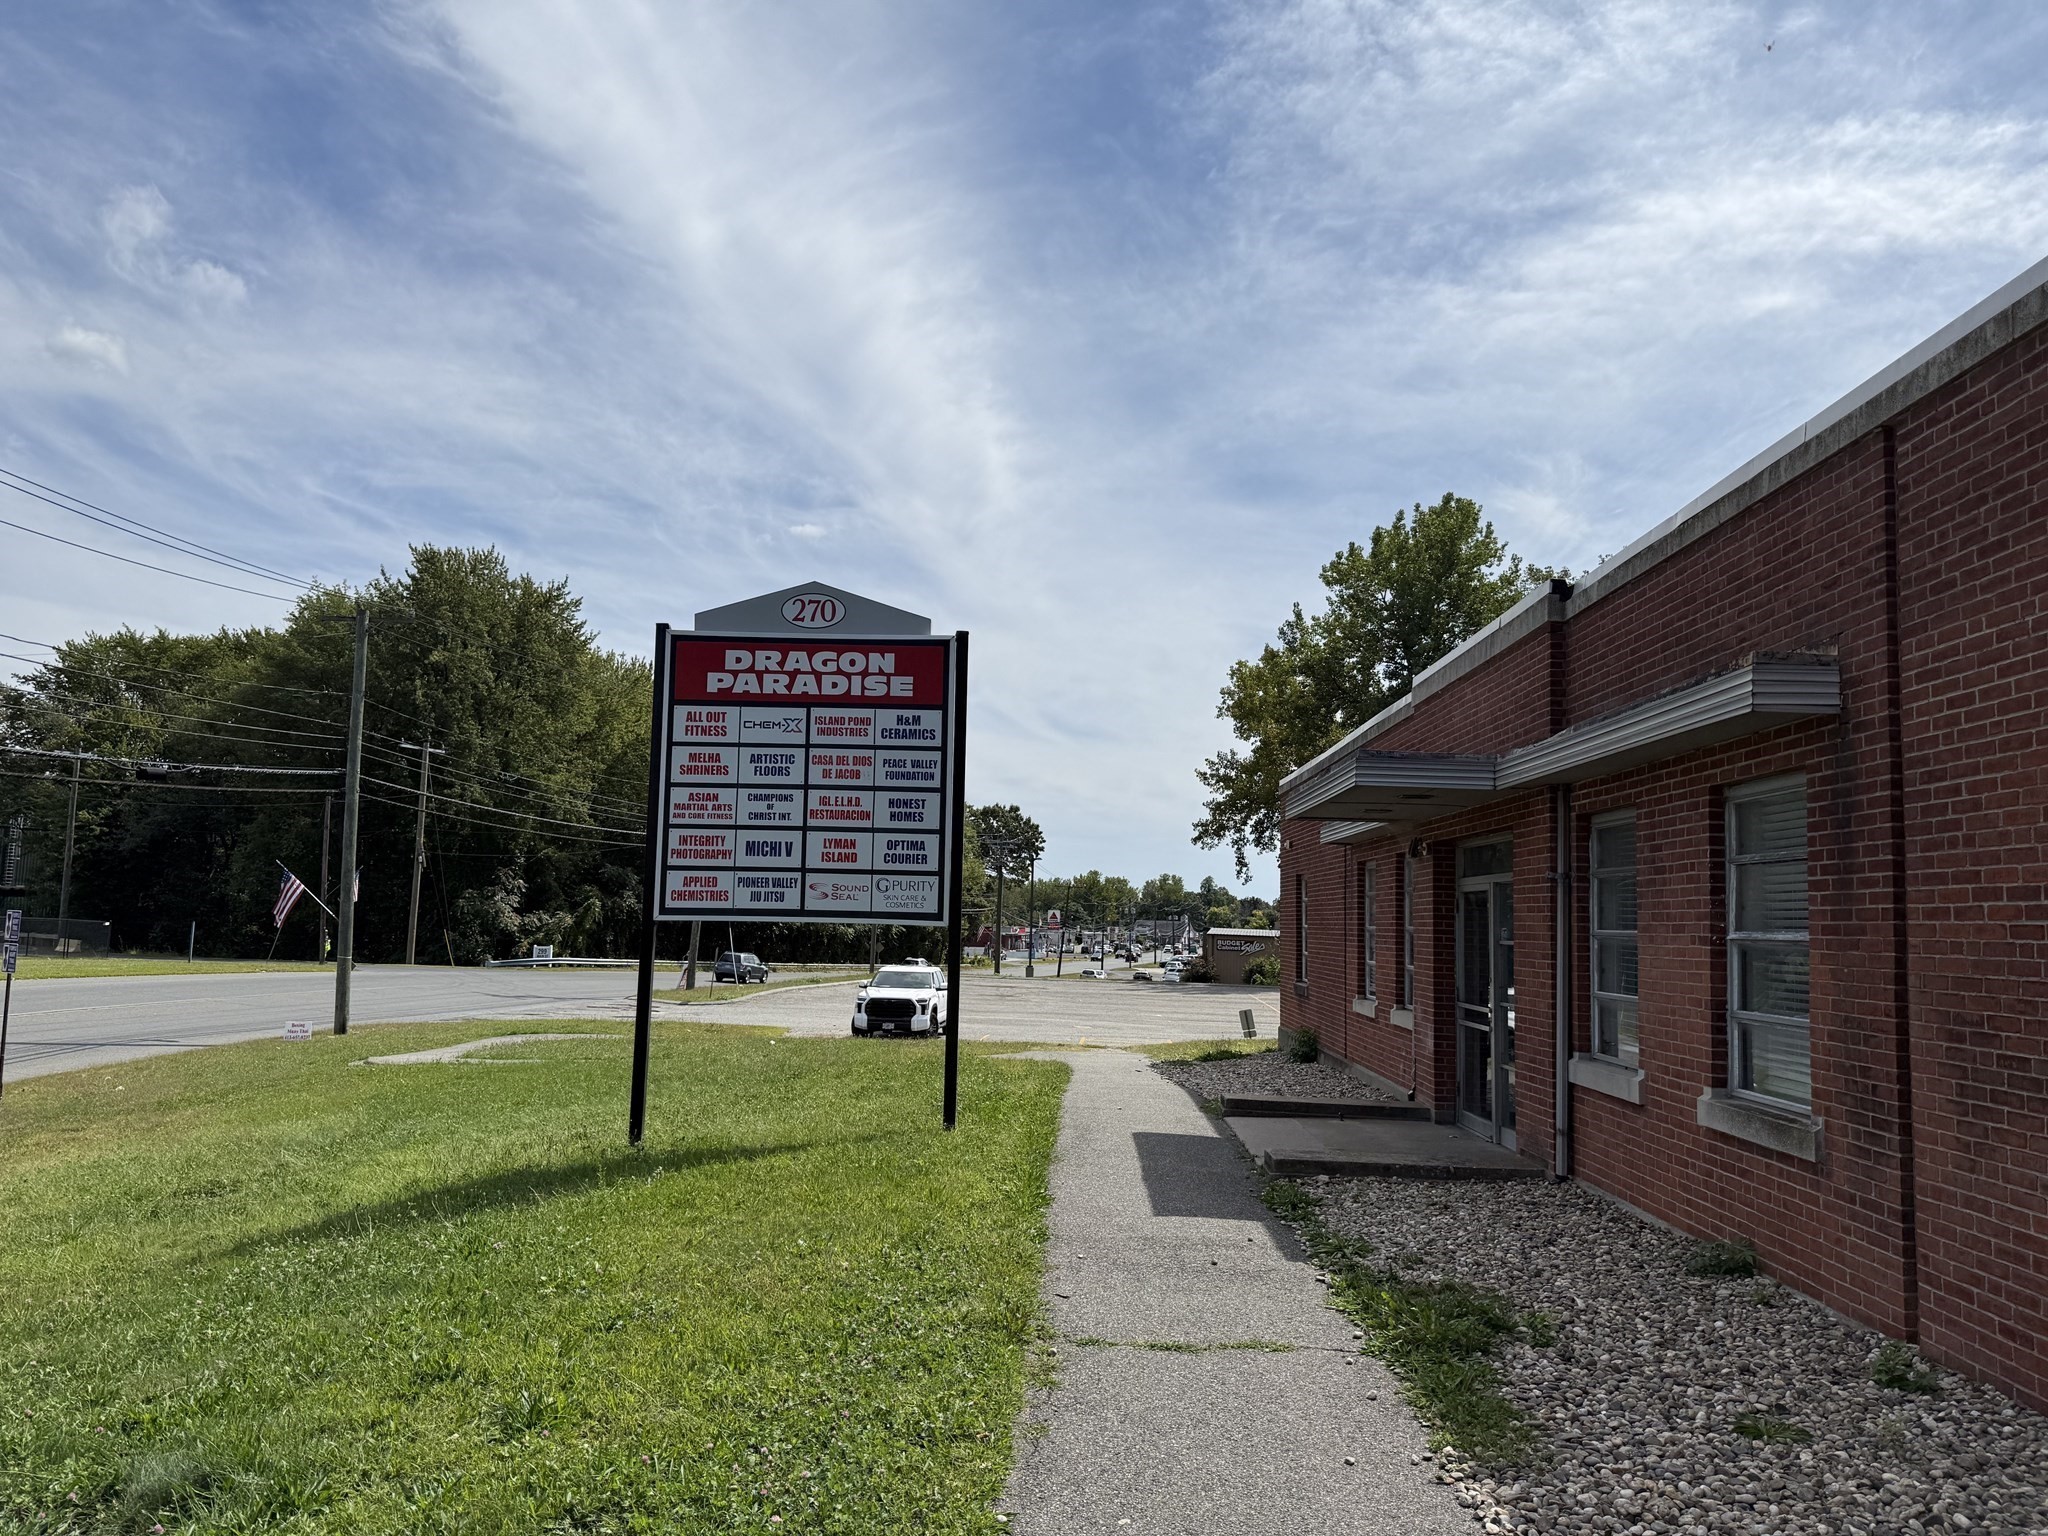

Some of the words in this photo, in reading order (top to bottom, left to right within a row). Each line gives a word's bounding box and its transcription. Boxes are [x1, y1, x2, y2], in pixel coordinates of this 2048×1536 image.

[791, 599, 836, 622] 270
[725, 650, 894, 673] DRAGON
[707, 672, 913, 697] PARADISE
[686, 711, 703, 723] ALL
[706, 711, 727, 723] OUT
[815, 716, 845, 727] ISLAND
[848, 716, 871, 727] POND
[897, 715, 921, 727] H&M
[685, 725, 727, 737] FITNESS
[744, 718, 803, 733] CHEM-X
[817, 727, 868, 737] INDUSTRIES
[881, 728, 936, 741] CERAMICS
[688, 753, 720, 764] MELHA
[750, 754, 795, 765] ARTISTIC
[811, 755, 833, 766] CASA
[836, 755, 850, 766] DEL
[852, 756, 872, 767] DIOS
[883, 758, 907, 769] PEACE
[911, 759, 937, 770] VALLEY
[679, 764, 729, 776] SHRINERS
[754, 765, 790, 777] FLOORS
[822, 768, 832, 779] DE
[834, 769, 861, 780] JACOB
[885, 771, 935, 781] FOUNDATION
[688, 793, 719, 803] ASIAN
[748, 793, 794, 803] CHAMPIONS
[889, 798, 926, 810] HONEST
[673, 802, 710, 811] MARTIAL
[712, 803, 732, 812] ARTS
[767, 803, 775, 811] OF
[688, 812, 704, 820] CORE
[748, 811, 776, 821] CHRIST
[778, 812, 792, 821] INT.
[809, 809, 871, 821] RESTAURACION
[889, 811, 924, 823] HOMES
[679, 835, 726, 847] INTEGRITY
[823, 838, 856, 850] LYMAN
[886, 839, 926, 852] OPTIMA
[671, 848, 733, 860] PHOTOGRAPHY
[745, 840, 782, 857] MICHI
[785, 841, 793, 858] V
[821, 851, 858, 863] ISLAND
[884, 853, 928, 865] COURIER
[683, 876, 718, 888] APPLIED
[737, 876, 770, 889] PIONEER
[772, 877, 799, 889] VALLEY
[832, 883, 869, 893] SOUND
[892, 880, 935, 892] PURITY
[671, 890, 729, 902] CHEMISTRIES
[750, 891, 761, 903] JIU
[764, 891, 785, 903] JITSU
[832, 893, 858, 901] SEAL
[885, 901, 924, 909] COSMETICS
[1240, 941, 1265, 955] Sales
